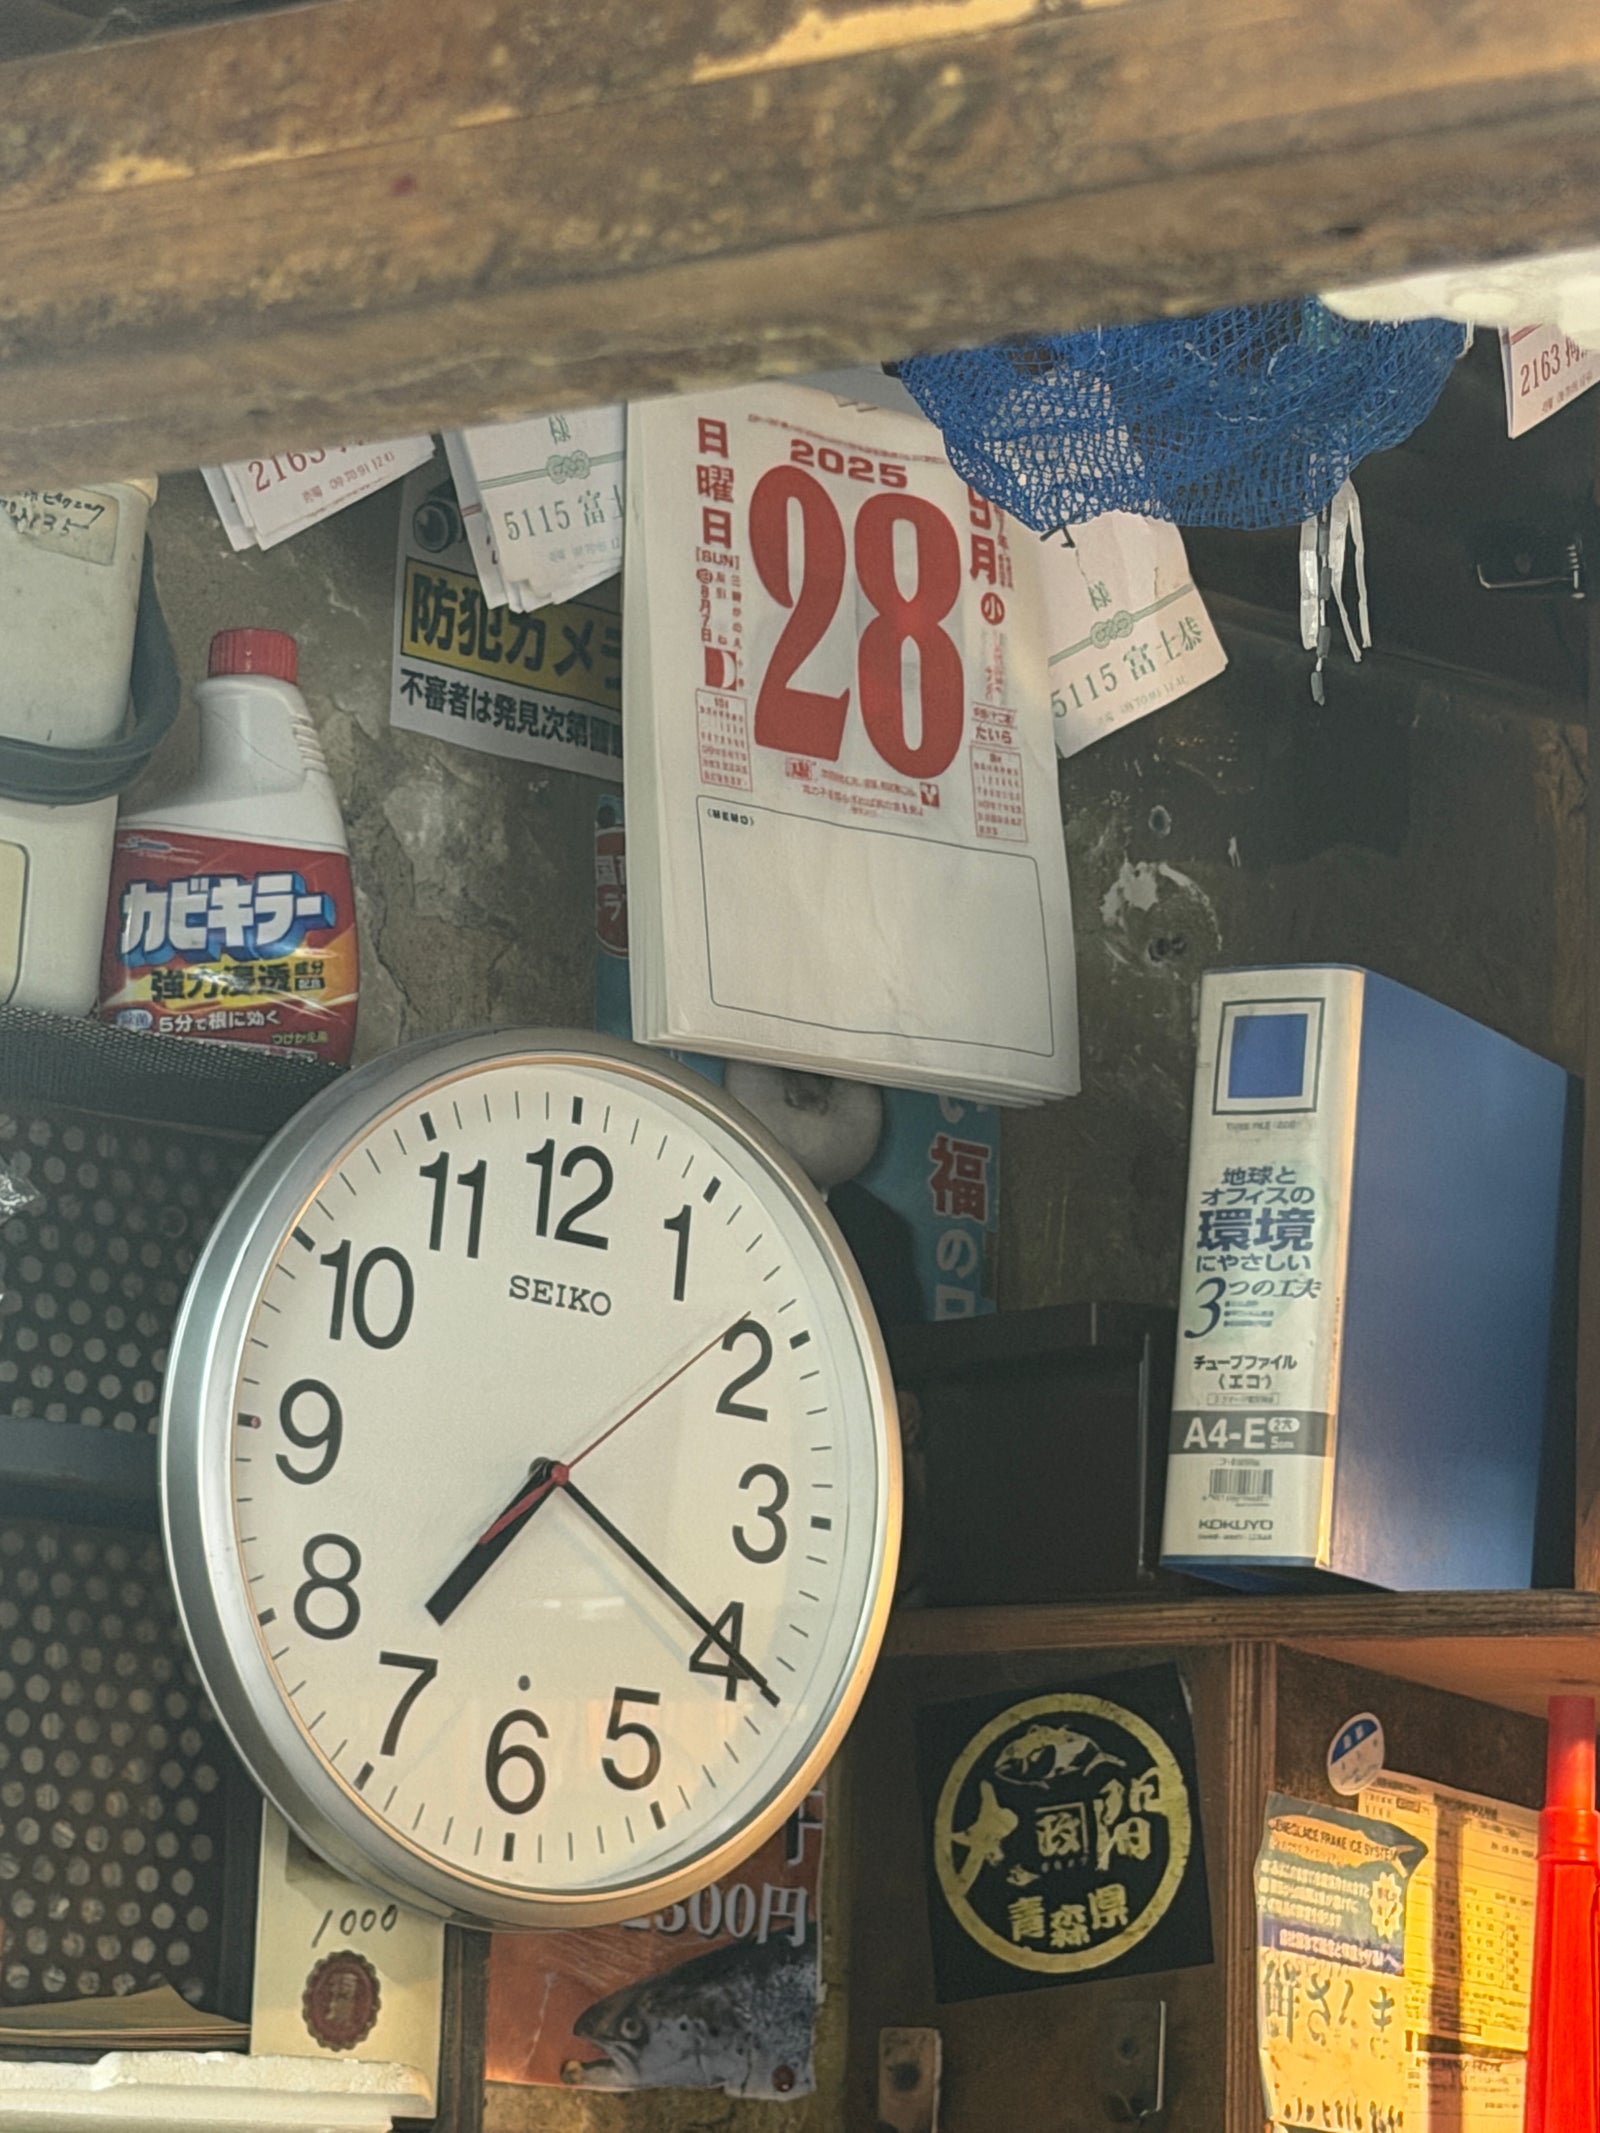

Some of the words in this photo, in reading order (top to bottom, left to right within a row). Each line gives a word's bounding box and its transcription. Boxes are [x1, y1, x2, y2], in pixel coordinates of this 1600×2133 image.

[1520, 344, 1561, 397] 2163
[697, 417, 735, 550] 日曜日
[790, 438, 908, 489] 2025
[504, 500, 571, 541] 5115
[748, 464, 965, 780] 28
[1051, 662, 1118, 718] 5115
[120, 872, 330, 956] カビキラー
[158, 1010, 282, 1033] 5分で根に効く
[418, 1151, 489, 1260] 11
[525, 1137, 616, 1252] 12
[1200, 1186, 1315, 1206] オフィスの
[1221, 1165, 1296, 1186] 地球と
[662, 1204, 693, 1302] 1
[1196, 1253, 1311, 1273] にやさしい
[1197, 1207, 1315, 1252] 環境
[319, 1238, 416, 1351] 10
[508, 1274, 613, 1317] SEIKO
[715, 1318, 774, 1423] 2
[1193, 1354, 1298, 1371] チューブファイル
[274, 1378, 344, 1486] 9
[1183, 1416, 1267, 1449] A4-E
[731, 1463, 790, 1565] 3
[1198, 1519, 1274, 1531] KOKUYO
[293, 1532, 362, 1641] 8
[688, 1601, 746, 1702] 4
[378, 1650, 440, 1757] 7
[600, 1685, 662, 1791] 5
[484, 1708, 550, 1816] 6
[311, 1904, 398, 1948] 1000
[1008, 1883, 1129, 1948] 青森県
